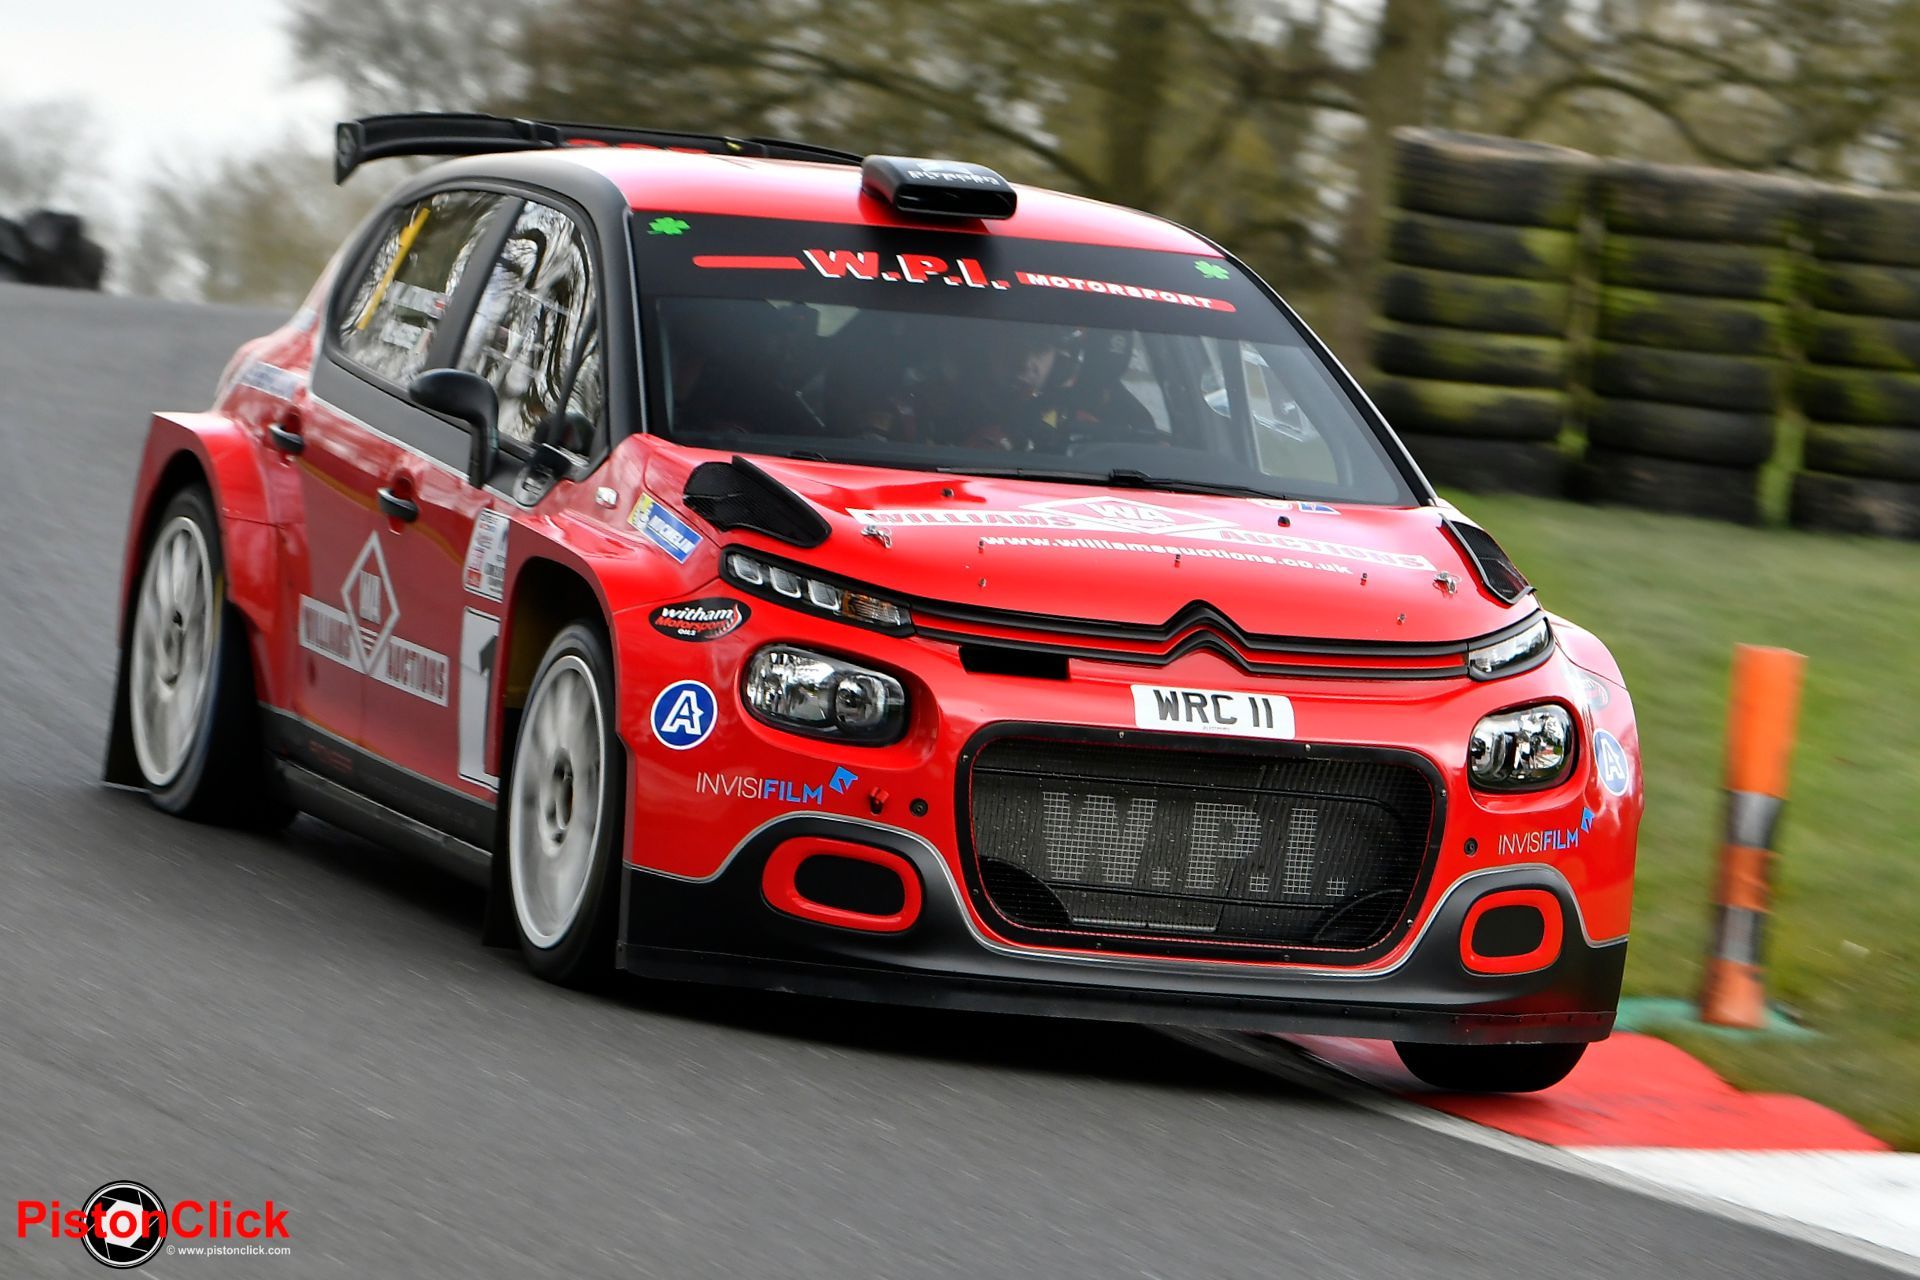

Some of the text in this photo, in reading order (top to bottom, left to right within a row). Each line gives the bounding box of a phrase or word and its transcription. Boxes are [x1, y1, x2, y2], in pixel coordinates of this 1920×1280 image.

[803, 248, 1213, 309] W.P.I. MOTORSPORT
[866, 511, 1076, 528] WILLIAMS
[1088, 503, 1176, 523] WA
[662, 606, 734, 621] witham
[1153, 689, 1237, 725] WRC
[696, 771, 823, 805] INVISIFILM
[1043, 791, 1348, 897] W.P.I.
[1498, 827, 1579, 855] INVISIFILM
